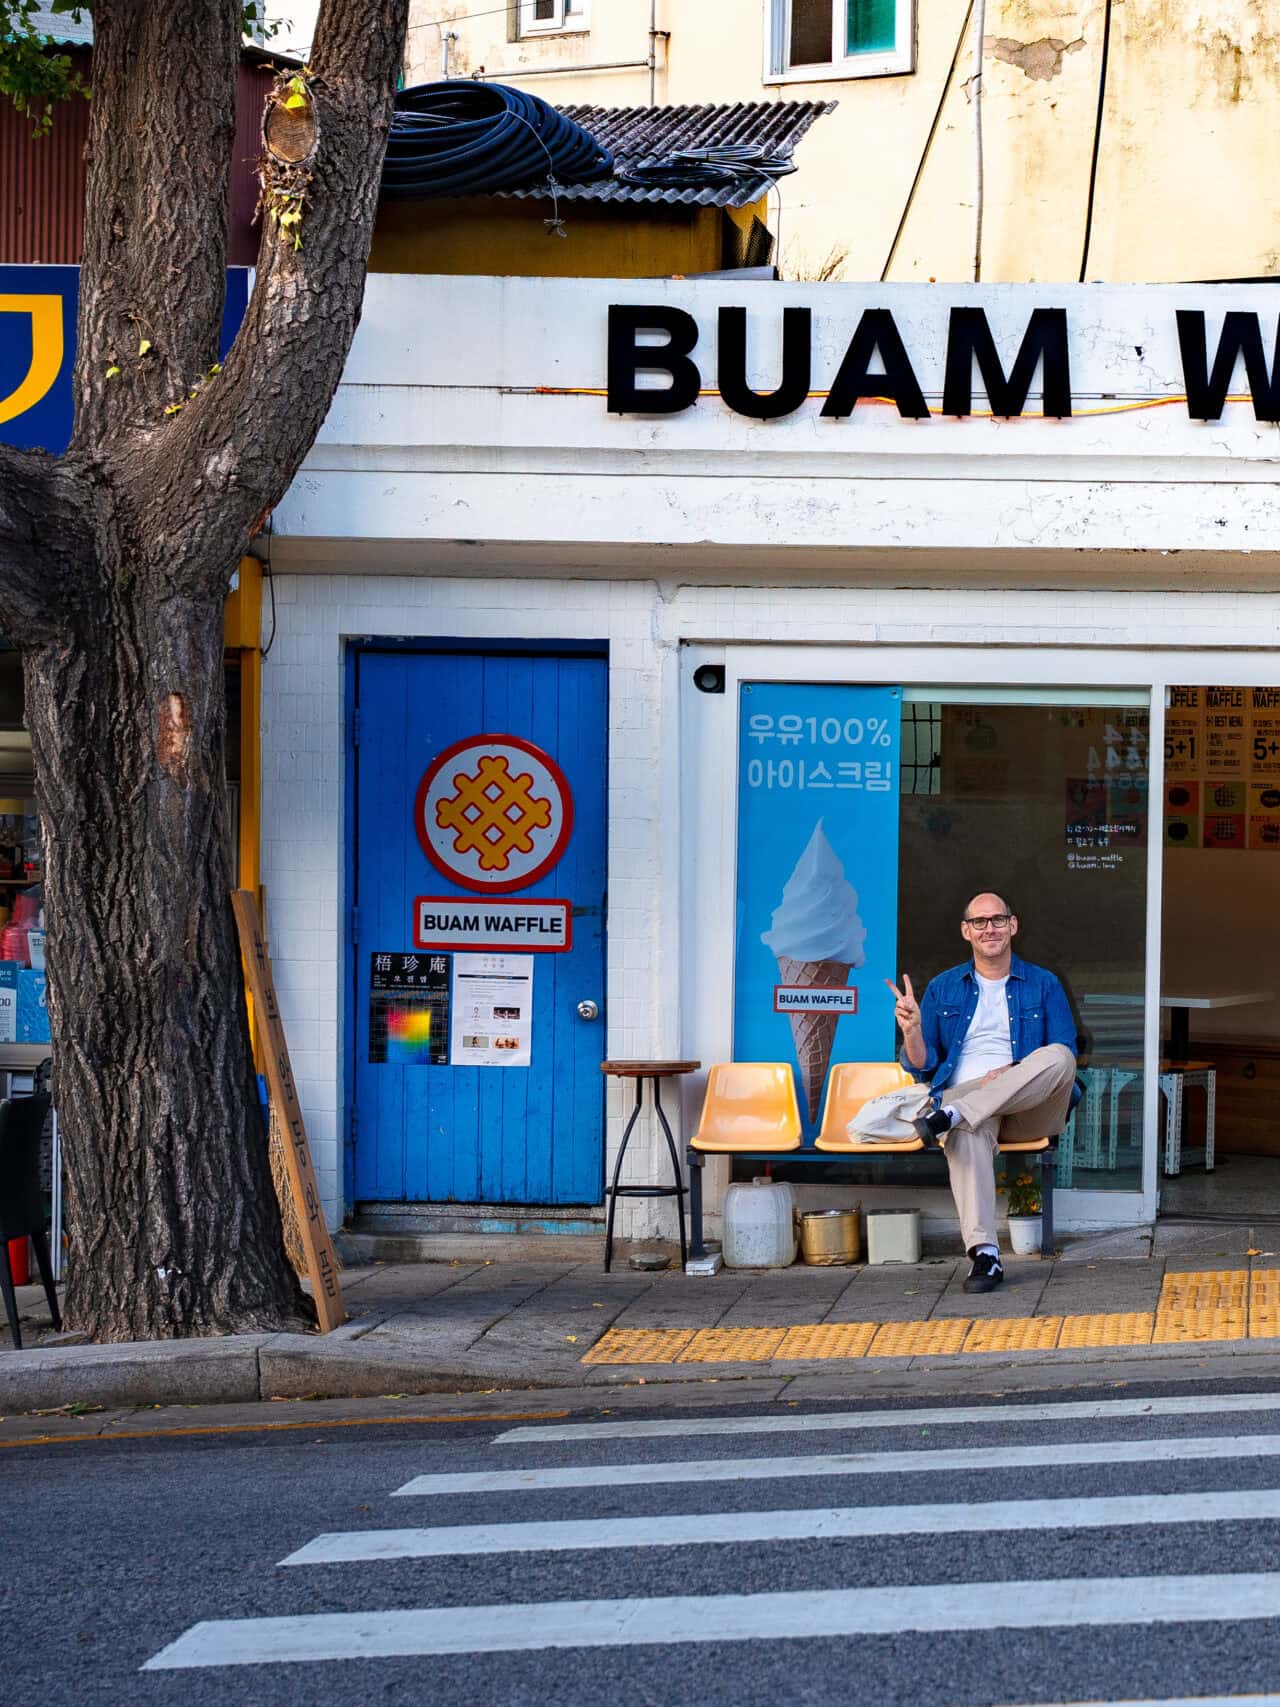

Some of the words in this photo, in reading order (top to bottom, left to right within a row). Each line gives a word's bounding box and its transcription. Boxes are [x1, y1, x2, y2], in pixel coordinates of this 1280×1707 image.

[608, 304, 1072, 420] BUAM
[748, 714, 891, 746] 우유100%
[748, 759, 891, 791] 아이스크림
[424, 914, 480, 932] BUAM
[485, 915, 562, 933] WAFFLE
[375, 954, 447, 974] 梧珍庵
[779, 994, 809, 1004] BUAM
[811, 995, 853, 1005] WAFFLE
